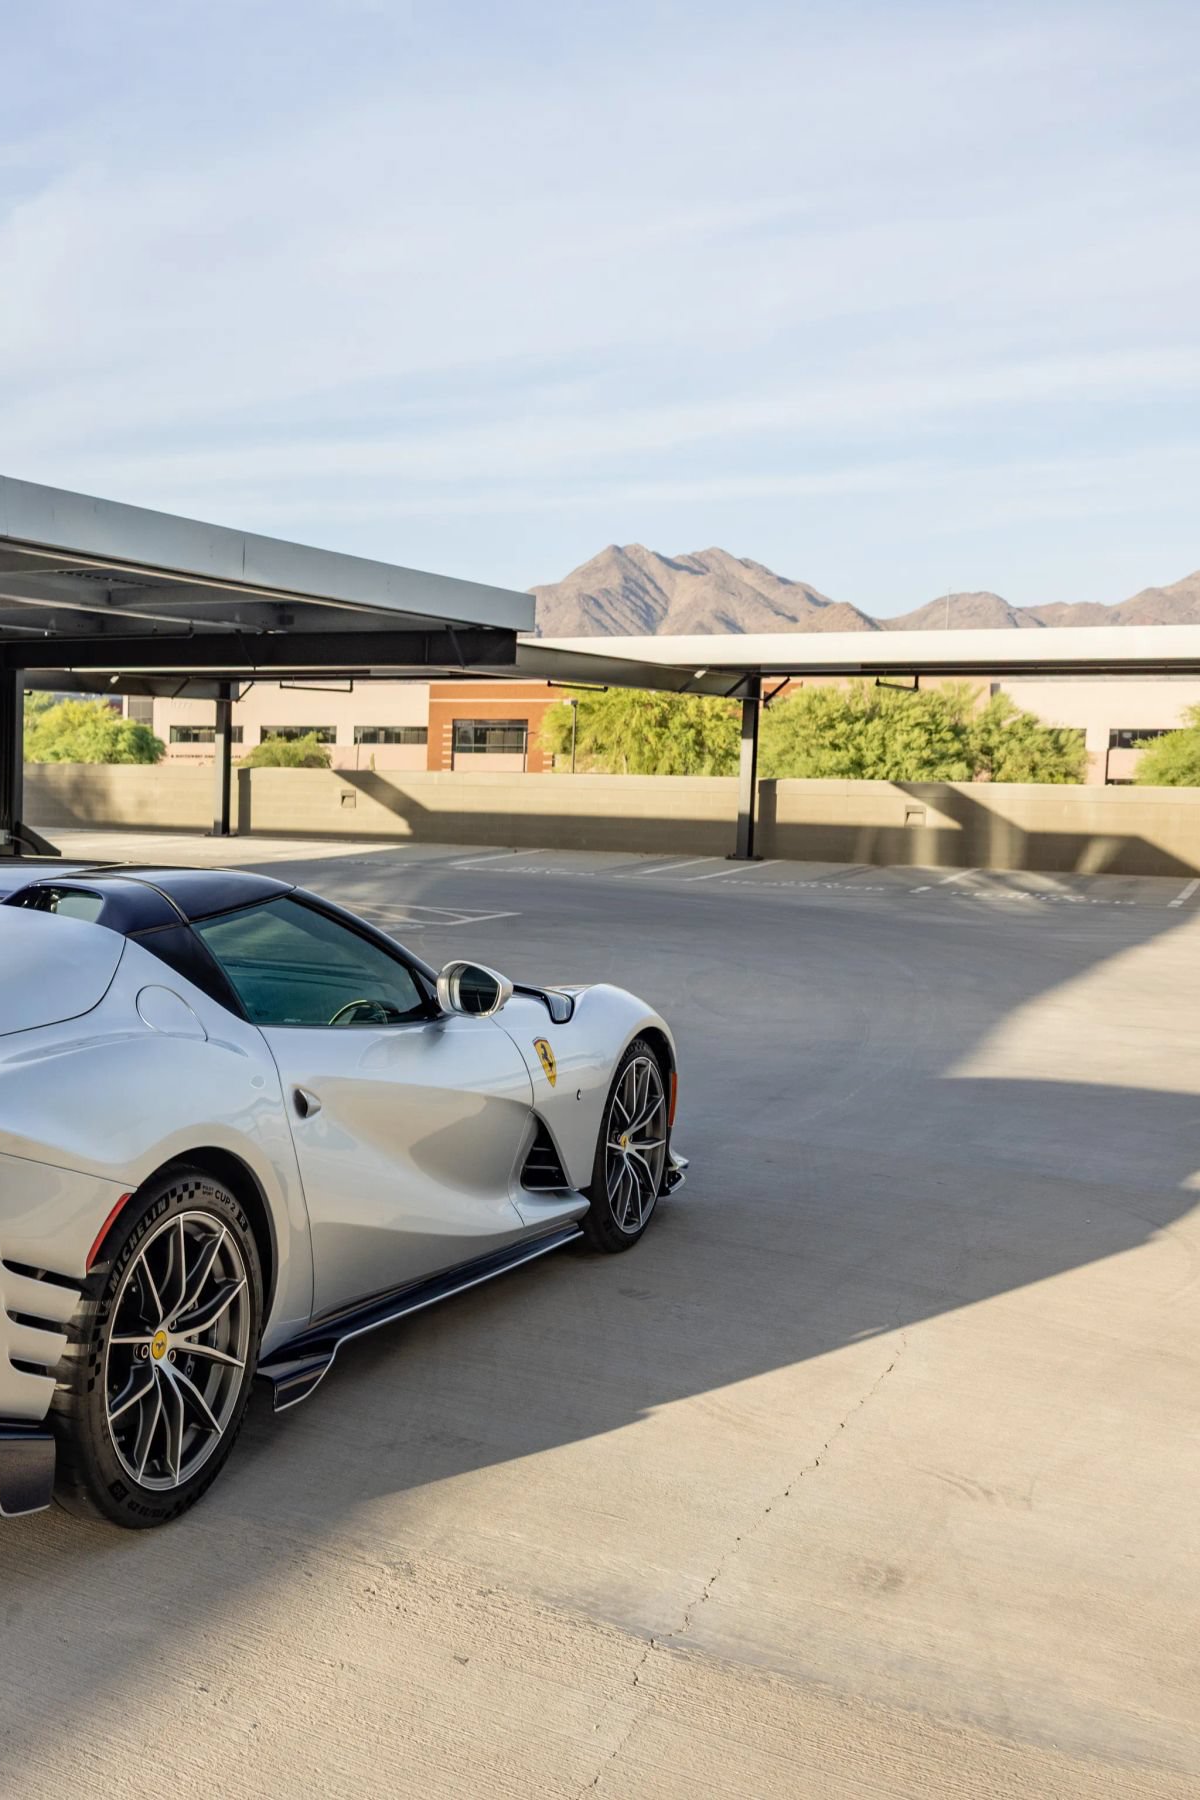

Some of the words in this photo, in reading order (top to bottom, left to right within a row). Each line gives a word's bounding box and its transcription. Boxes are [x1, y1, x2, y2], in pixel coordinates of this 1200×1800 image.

[214, 1190, 231, 1205] CUP
[230, 1202, 236, 1212] 2
[108, 1198, 167, 1294] MICHELIN
